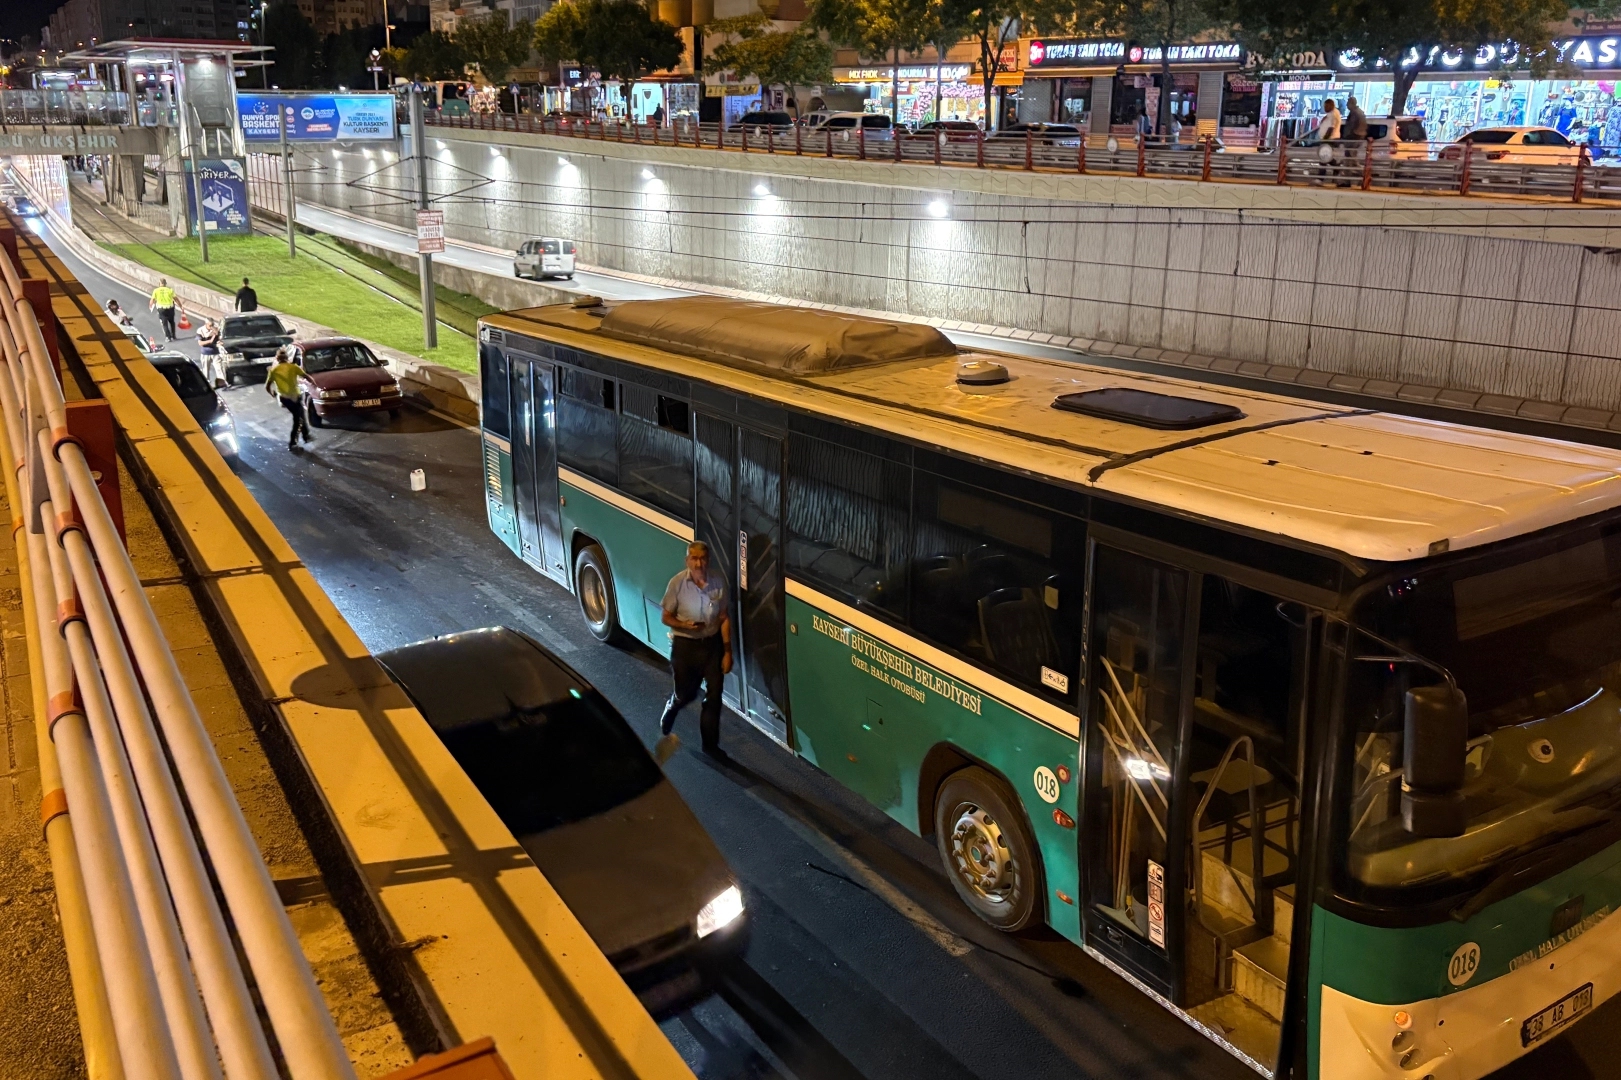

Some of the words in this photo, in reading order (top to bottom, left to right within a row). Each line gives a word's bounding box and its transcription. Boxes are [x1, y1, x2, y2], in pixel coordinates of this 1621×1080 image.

[1100, 42, 1125, 57] TOKA
[1208, 44, 1240, 58] TOKA
[888, 67, 928, 78] DNDURMA
[812, 614, 850, 647] KAYSERİ
[851, 633, 913, 677] BÜYÜKŞEHİR
[914, 665, 982, 716] BELEDİYESİ
[851, 653, 870, 672] ÖZEL
[870, 667, 890, 684] HALK
[890, 676, 926, 705] OTOBÜSÜ
[1036, 771, 1057, 799] 018
[1451, 948, 1477, 979] 018
